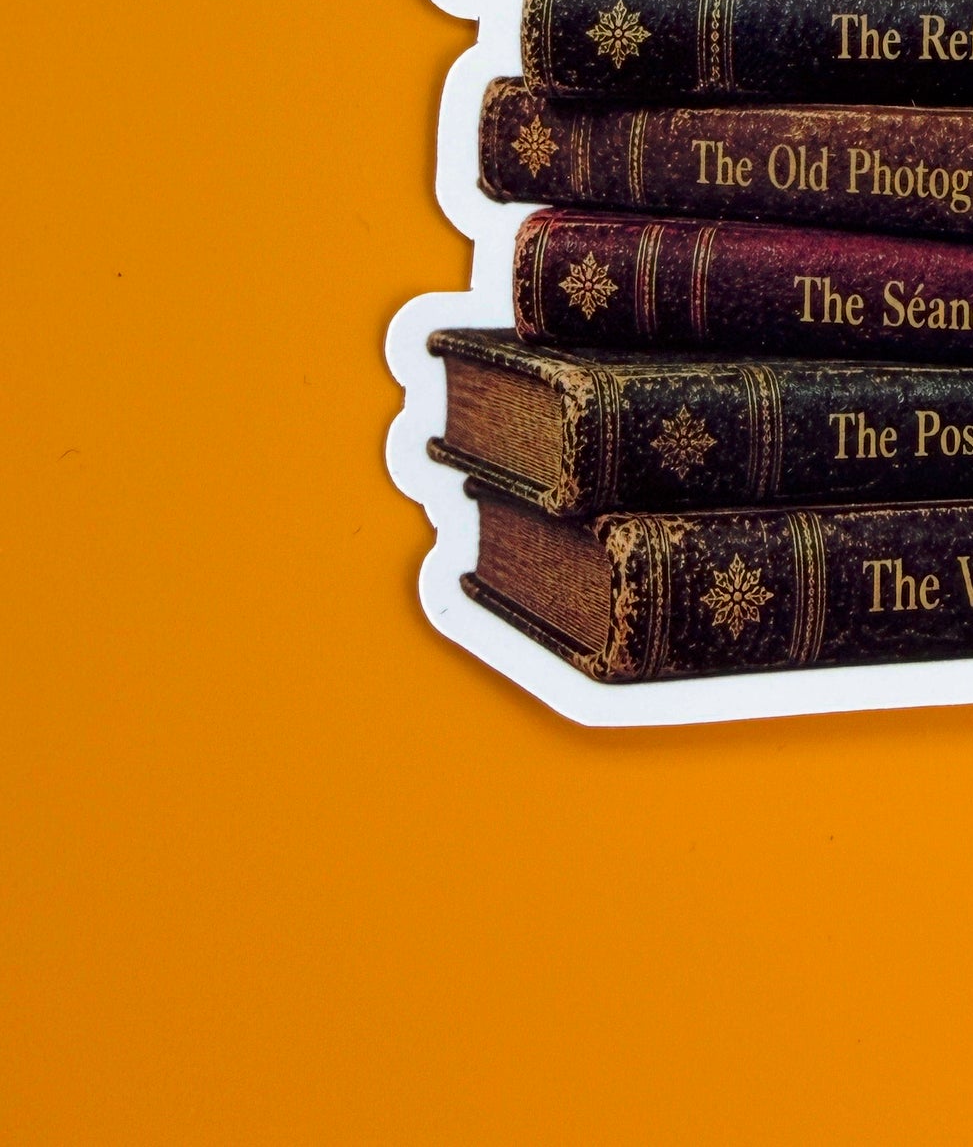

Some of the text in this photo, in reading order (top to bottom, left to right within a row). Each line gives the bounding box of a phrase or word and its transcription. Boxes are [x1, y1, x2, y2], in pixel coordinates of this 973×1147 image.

[830, 13, 902, 60] The
[690, 139, 753, 187] The
[767, 143, 830, 192] Old
[793, 275, 865, 326] The
[828, 411, 898, 460] The
[862, 557, 940, 613] The
